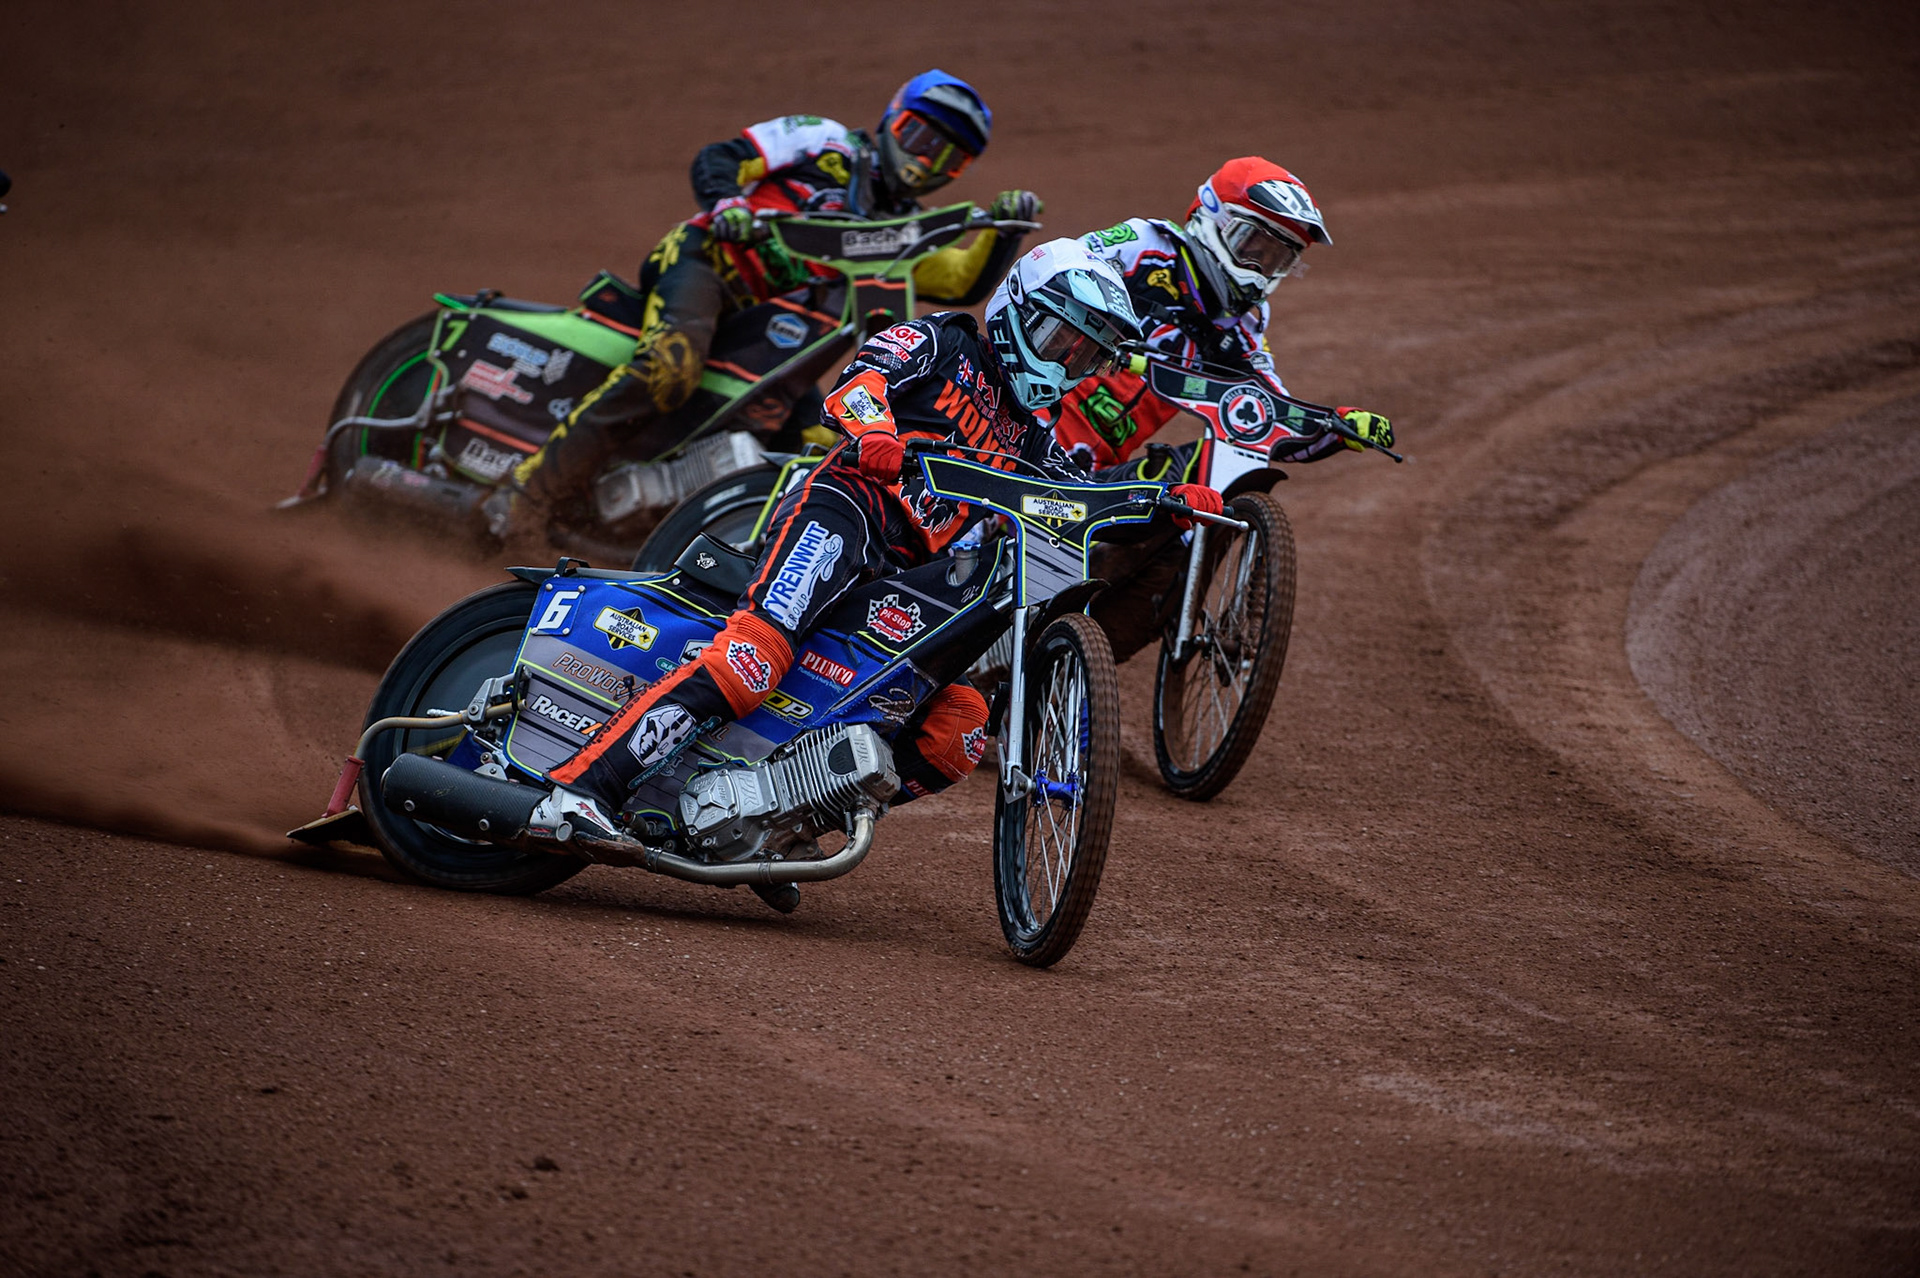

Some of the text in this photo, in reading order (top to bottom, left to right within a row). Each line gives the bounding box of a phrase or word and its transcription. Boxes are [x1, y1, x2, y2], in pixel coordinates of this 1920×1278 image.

[440, 320, 469, 351] 7
[1224, 388, 1243, 404] BELLE
[1033, 498, 1075, 509] AUSTRALIAN
[1044, 504, 1064, 513] ROAD
[1038, 509, 1069, 519] SERVICES
[537, 590, 580, 630] 6
[785, 593, 808, 629] GROUP
[609, 612, 649, 633] AUSTRALIAN
[615, 620, 636, 633] ROAD
[892, 614, 912, 629] Stop
[607, 625, 637, 642] SERVICES
[737, 651, 763, 682] Pit Stop
[801, 651, 854, 687] PLUMCO
[633, 757, 669, 786] autocraft
